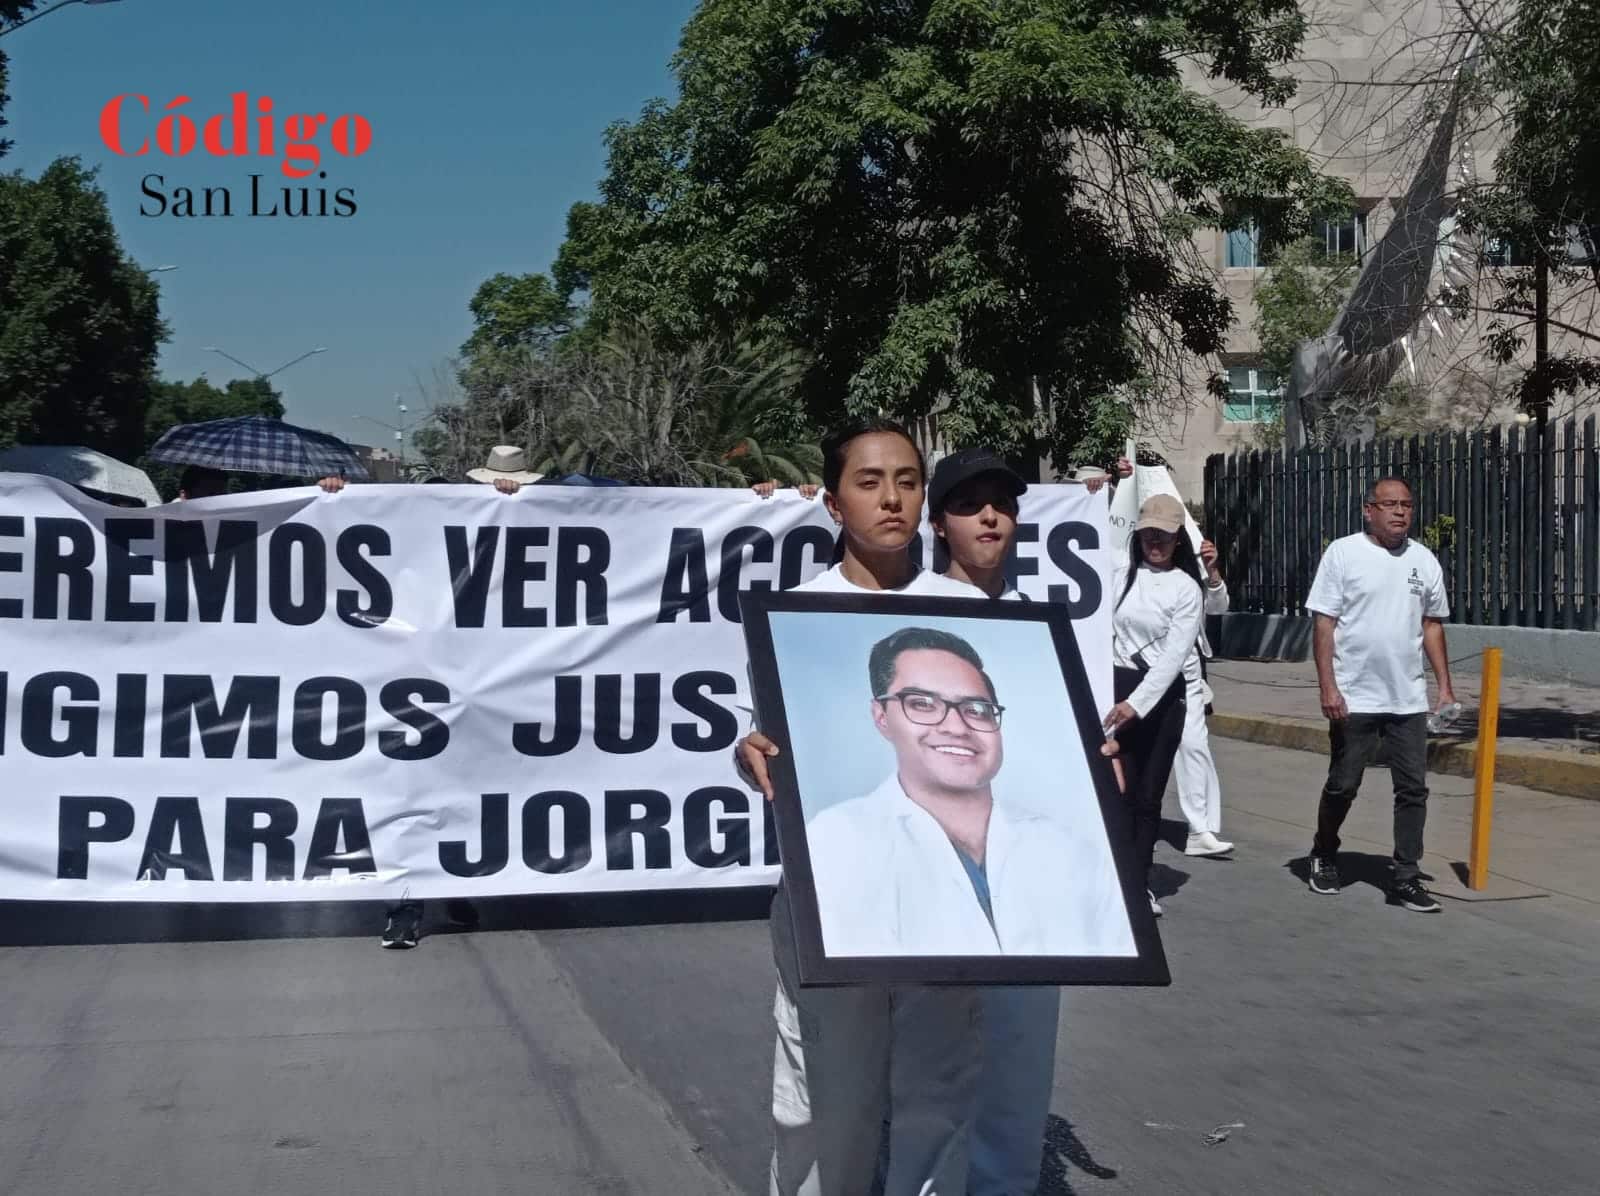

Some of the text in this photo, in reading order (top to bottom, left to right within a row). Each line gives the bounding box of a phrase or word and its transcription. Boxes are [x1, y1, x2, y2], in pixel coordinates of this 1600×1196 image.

[444, 526, 611, 628] VER
[0, 670, 738, 761] GIMOS JUS
[57, 796, 377, 881] PARA
